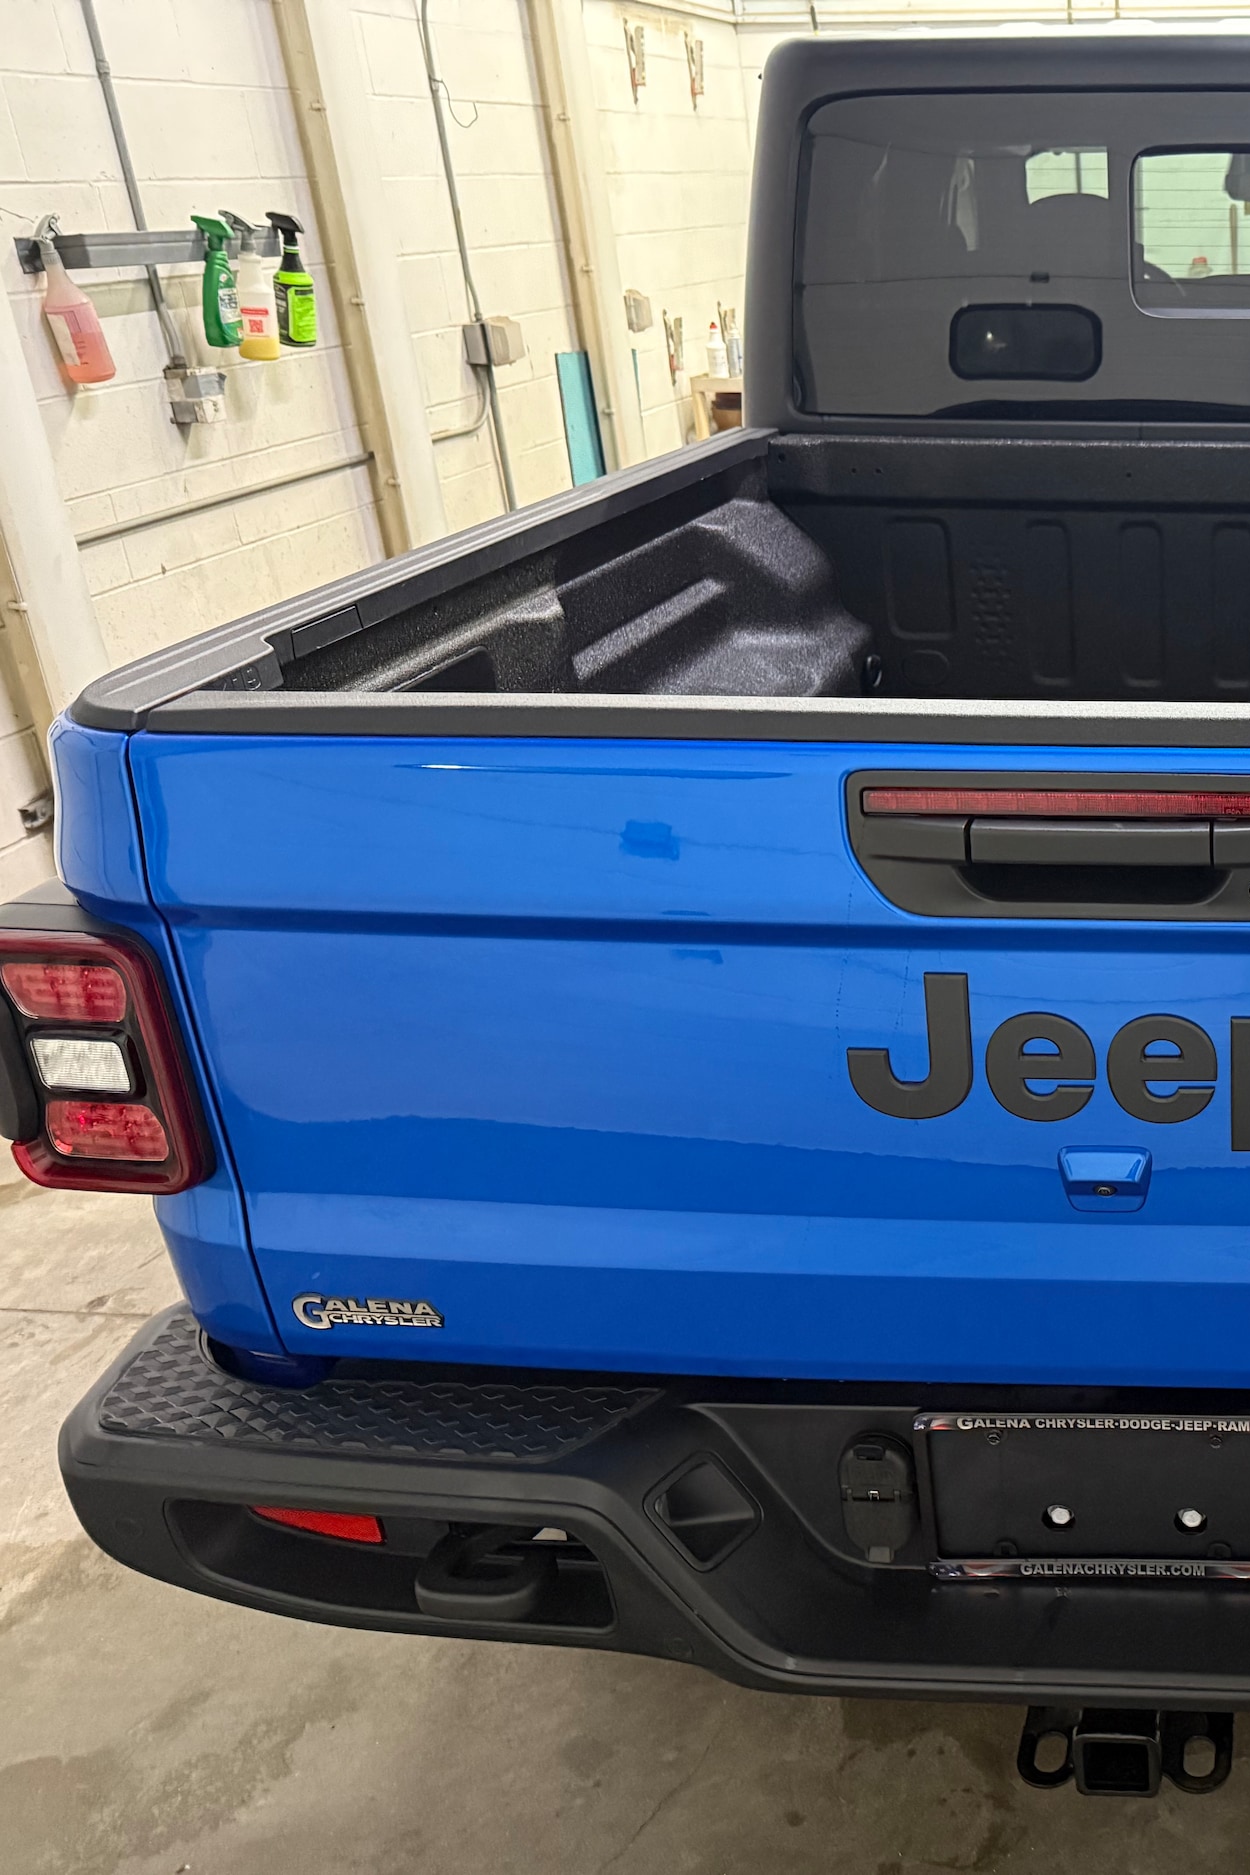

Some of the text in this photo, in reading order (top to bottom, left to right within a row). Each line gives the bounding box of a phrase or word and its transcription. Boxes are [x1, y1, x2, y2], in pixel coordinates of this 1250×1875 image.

[292, 1293, 437, 1330] GALENA
[328, 1312, 443, 1327] CHRYSLER
[956, 1417, 1032, 1430] GALENA
[1020, 1562, 1206, 1577] GALENACHRYSLER.COM
